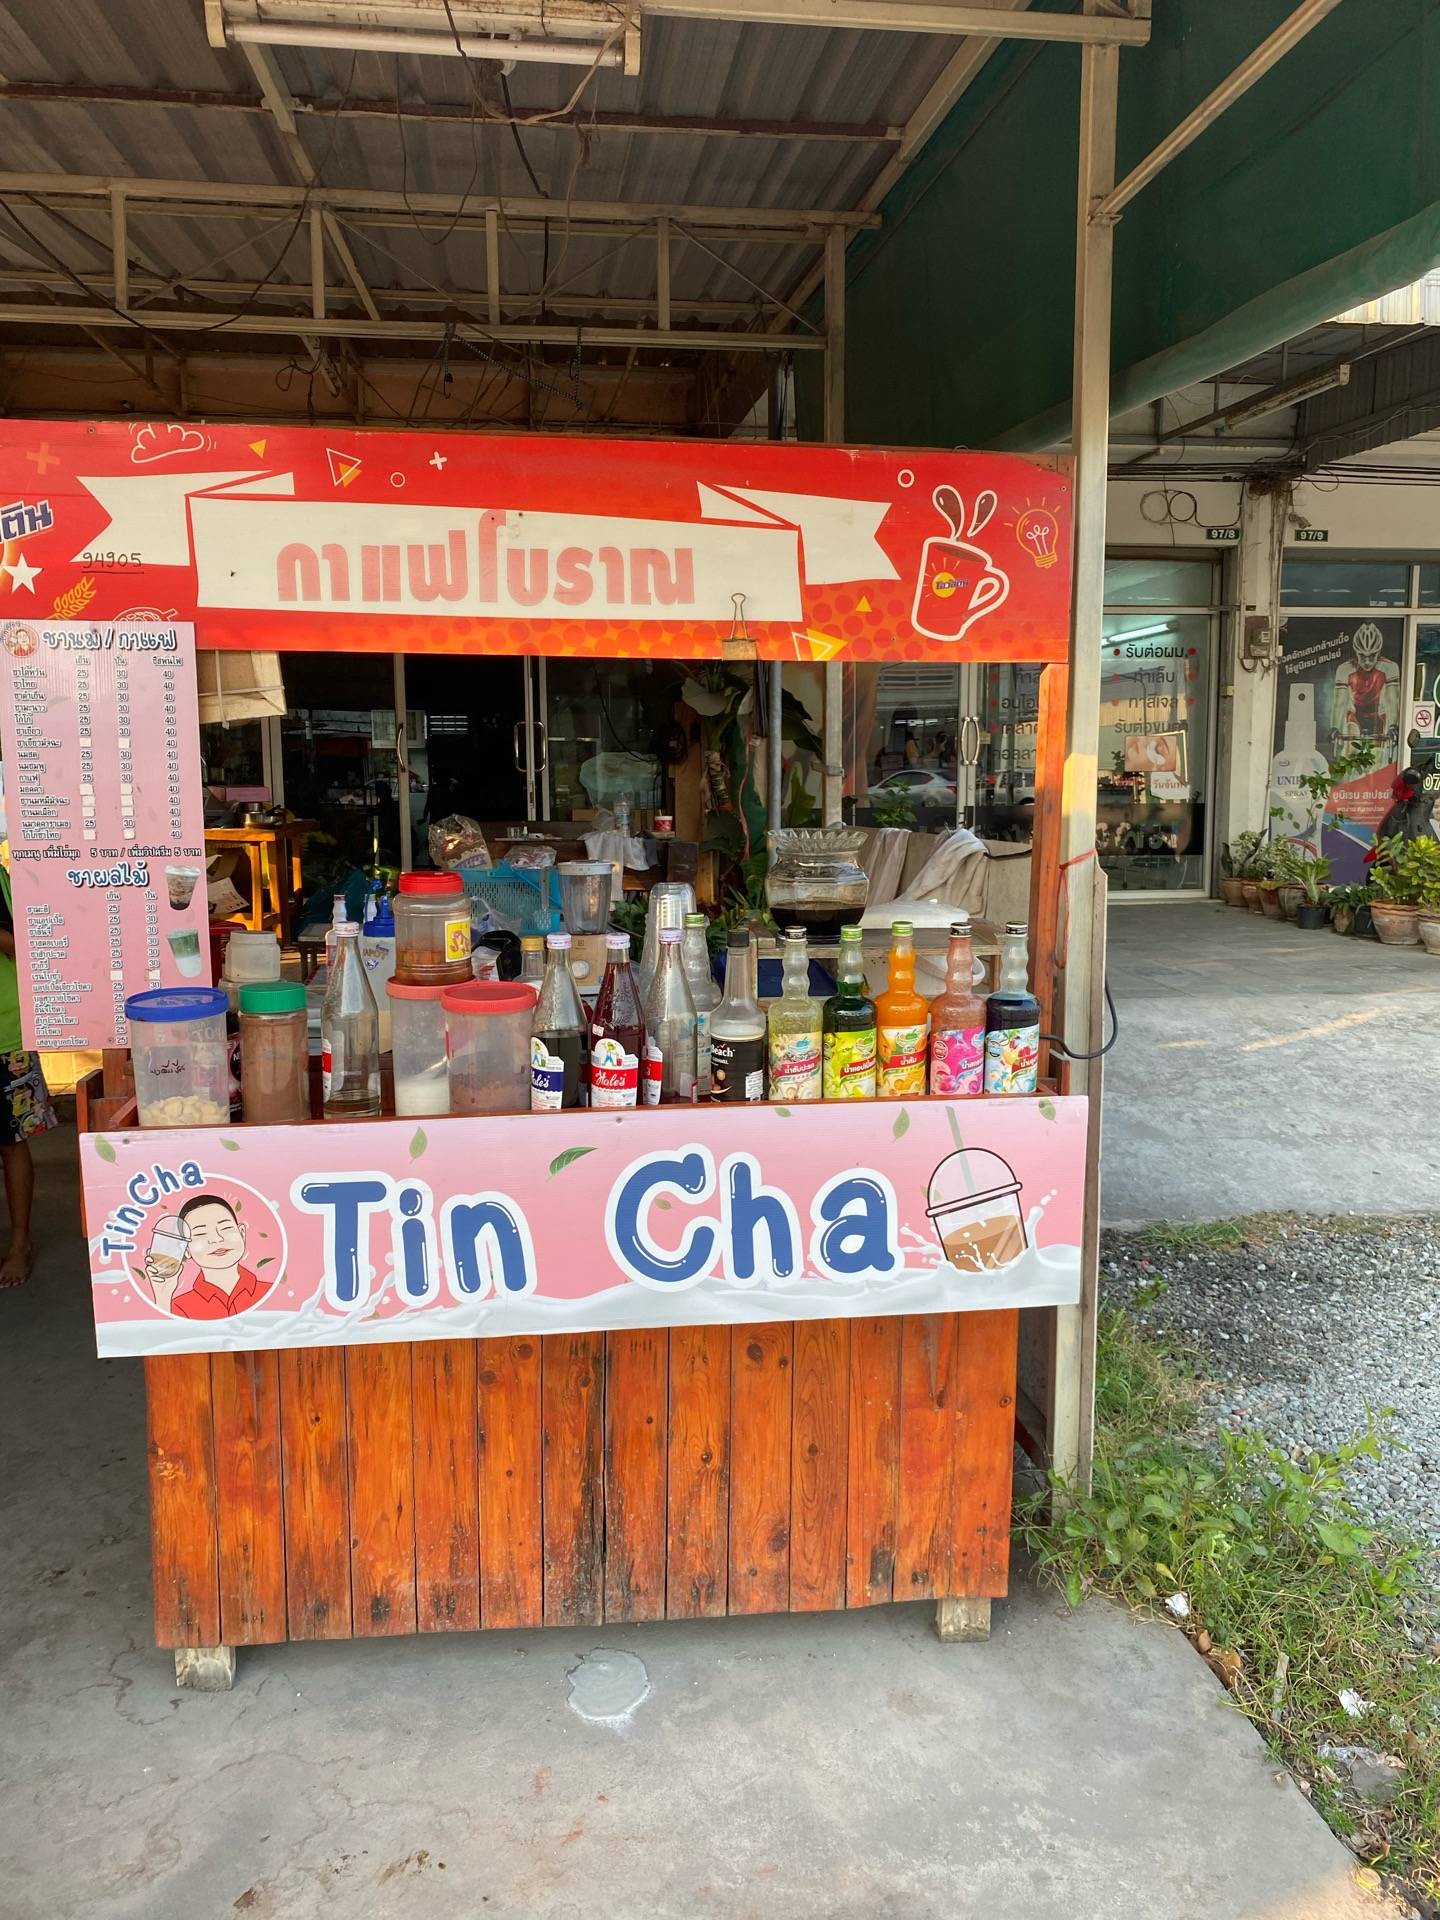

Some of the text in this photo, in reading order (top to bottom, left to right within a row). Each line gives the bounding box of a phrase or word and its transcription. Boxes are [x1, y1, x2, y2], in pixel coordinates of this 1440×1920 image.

[1211, 529, 1236, 539] 97/8
[1300, 531, 1324, 540] 97/9
[82, 551, 143, 569] 94905
[276, 508, 696, 607] กาแฟโบราณ
[118, 628, 176, 649] กาแฟ
[77, 669, 88, 677] 25
[116, 669, 127, 677] 30
[162, 670, 174, 678] 40
[78, 681, 89, 689] 25
[117, 681, 128, 689] 30
[163, 682, 174, 690] 40
[78, 692, 89, 701] 25
[118, 692, 129, 701] 30
[164, 693, 175, 701] 40
[79, 704, 90, 712] 25
[118, 704, 129, 712] 30
[164, 705, 175, 713] 40
[79, 716, 90, 724] 25
[119, 716, 130, 724] 30
[165, 716, 176, 724] 40
[80, 727, 91, 736] 25
[119, 727, 130, 736] 30
[165, 728, 176, 736] 40
[166, 739, 177, 748] 40
[81, 751, 92, 759] 25
[120, 751, 131, 759] 30
[167, 751, 178, 759] 40
[82, 762, 93, 770] 25
[121, 762, 132, 770] 30
[167, 762, 178, 771] 40
[82, 774, 93, 782] 25
[122, 774, 133, 782] 30
[168, 774, 179, 782] 40
[168, 785, 179, 794] 40
[169, 797, 180, 805] 40
[169, 808, 180, 816] 40
[85, 819, 96, 828] 25
[124, 819, 135, 828] 30
[170, 820, 181, 828] 40
[171, 830, 182, 839] 40
[90, 848, 97, 858] 5
[100, 849, 118, 857] บาท
[174, 847, 181, 856] 5
[183, 847, 201, 857] บาท
[66, 861, 148, 885] ชาผลไม้
[108, 904, 119, 912] 25
[146, 904, 157, 912] 30
[109, 915, 120, 924] 25
[147, 915, 157, 923] 30
[110, 927, 121, 935] 25
[147, 926, 158, 934] 30
[110, 938, 121, 946] 25
[148, 937, 159, 945] 30
[111, 949, 122, 957] 25
[149, 948, 159, 956] 30
[112, 960, 123, 968] 25
[149, 959, 160, 967] 30
[113, 982, 124, 990] 25
[114, 993, 125, 1001] 25
[115, 1004, 125, 1012] 25
[115, 1015, 126, 1023] 25
[116, 1026, 127, 1034] 25
[117, 1036, 128, 1045] 25
[595, 1070, 626, 1087] Hale's
[300, 1152, 896, 1302] Tin Cha
